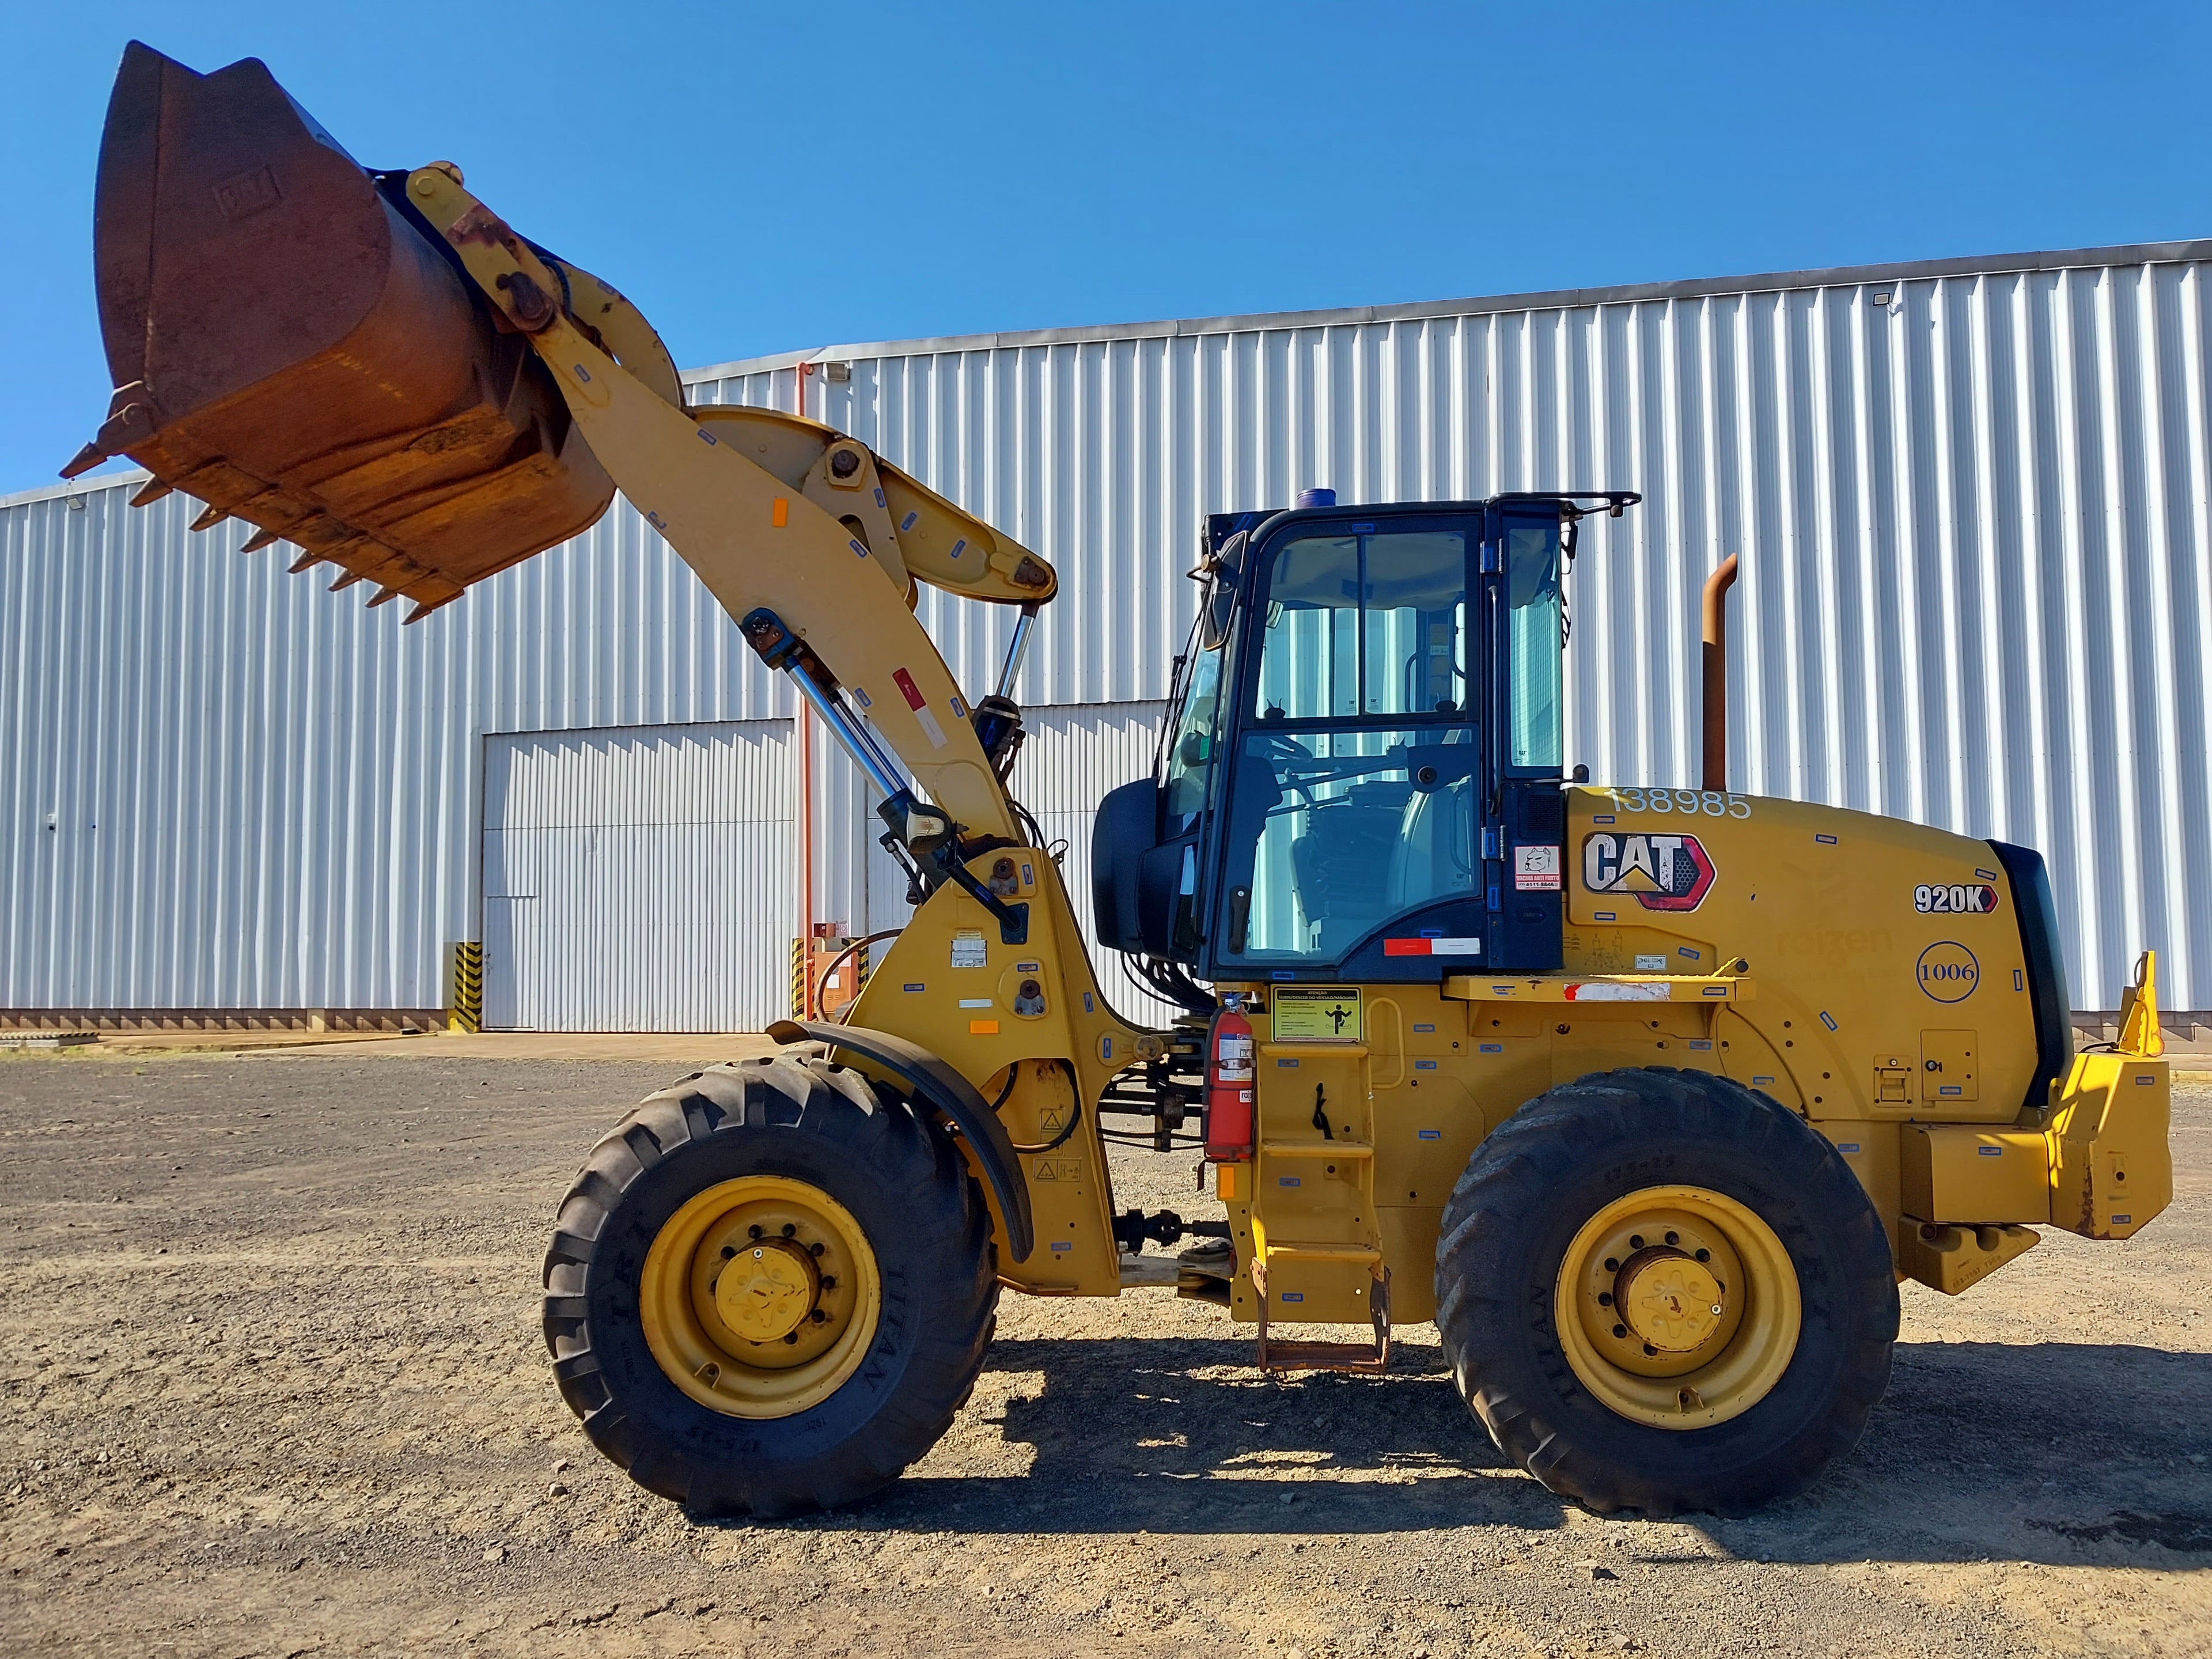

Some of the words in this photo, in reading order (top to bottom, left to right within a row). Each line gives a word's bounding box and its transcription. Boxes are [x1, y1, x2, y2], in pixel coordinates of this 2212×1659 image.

[1604, 787, 1751, 819] 138985
[1586, 834, 1681, 892] CAT
[1915, 886, 1984, 911] 920K
[1921, 963, 1975, 981] 1006
[864, 1266, 908, 1393] TITAN
